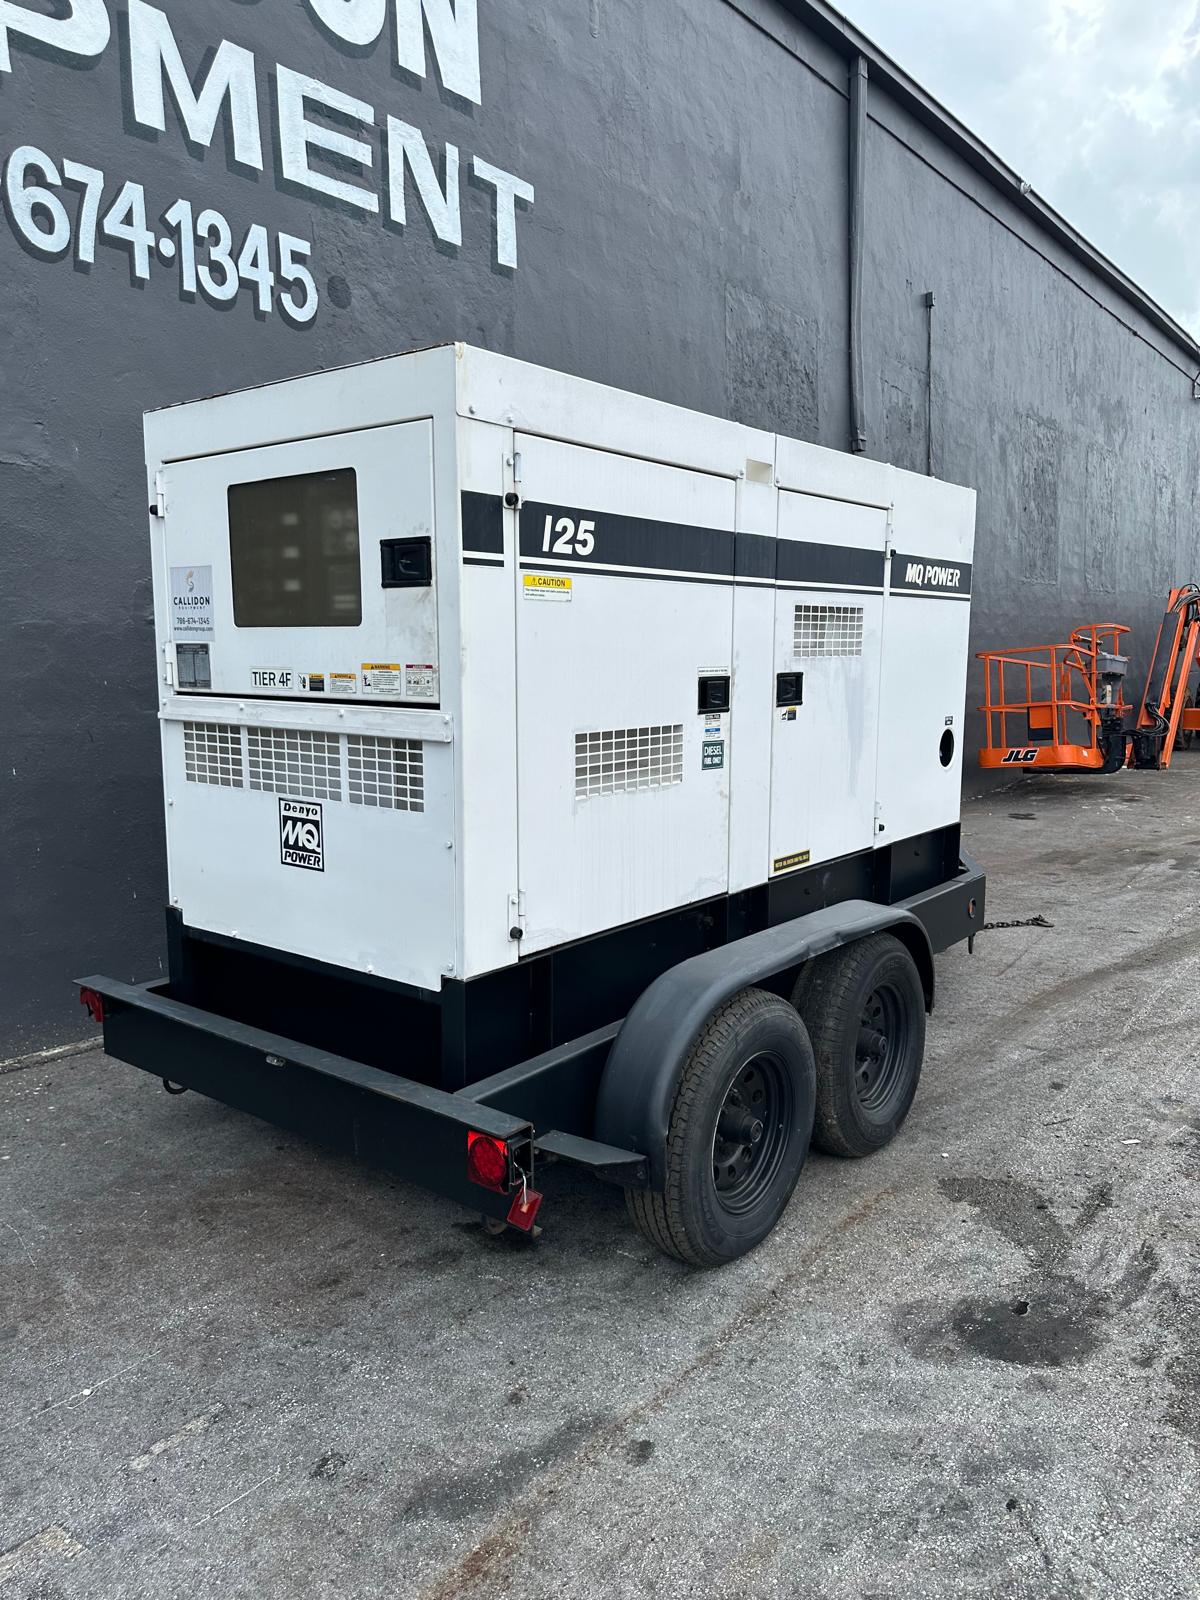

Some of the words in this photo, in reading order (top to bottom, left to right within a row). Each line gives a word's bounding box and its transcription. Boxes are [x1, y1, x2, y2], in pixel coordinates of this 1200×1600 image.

[542, 514, 595, 556] 125
[537, 577, 566, 587] CAUTION
[905, 563, 924, 587] MQ
[924, 565, 960, 587] POWER
[173, 596, 210, 606] CALLIDON
[252, 671, 276, 686] TIER
[278, 672, 292, 687] 4F
[704, 746, 722, 756] DIESEL
[1002, 749, 1038, 762] JLG
[283, 802, 318, 817] Denyo
[282, 820, 321, 853] MQ
[284, 850, 321, 867] POWER
